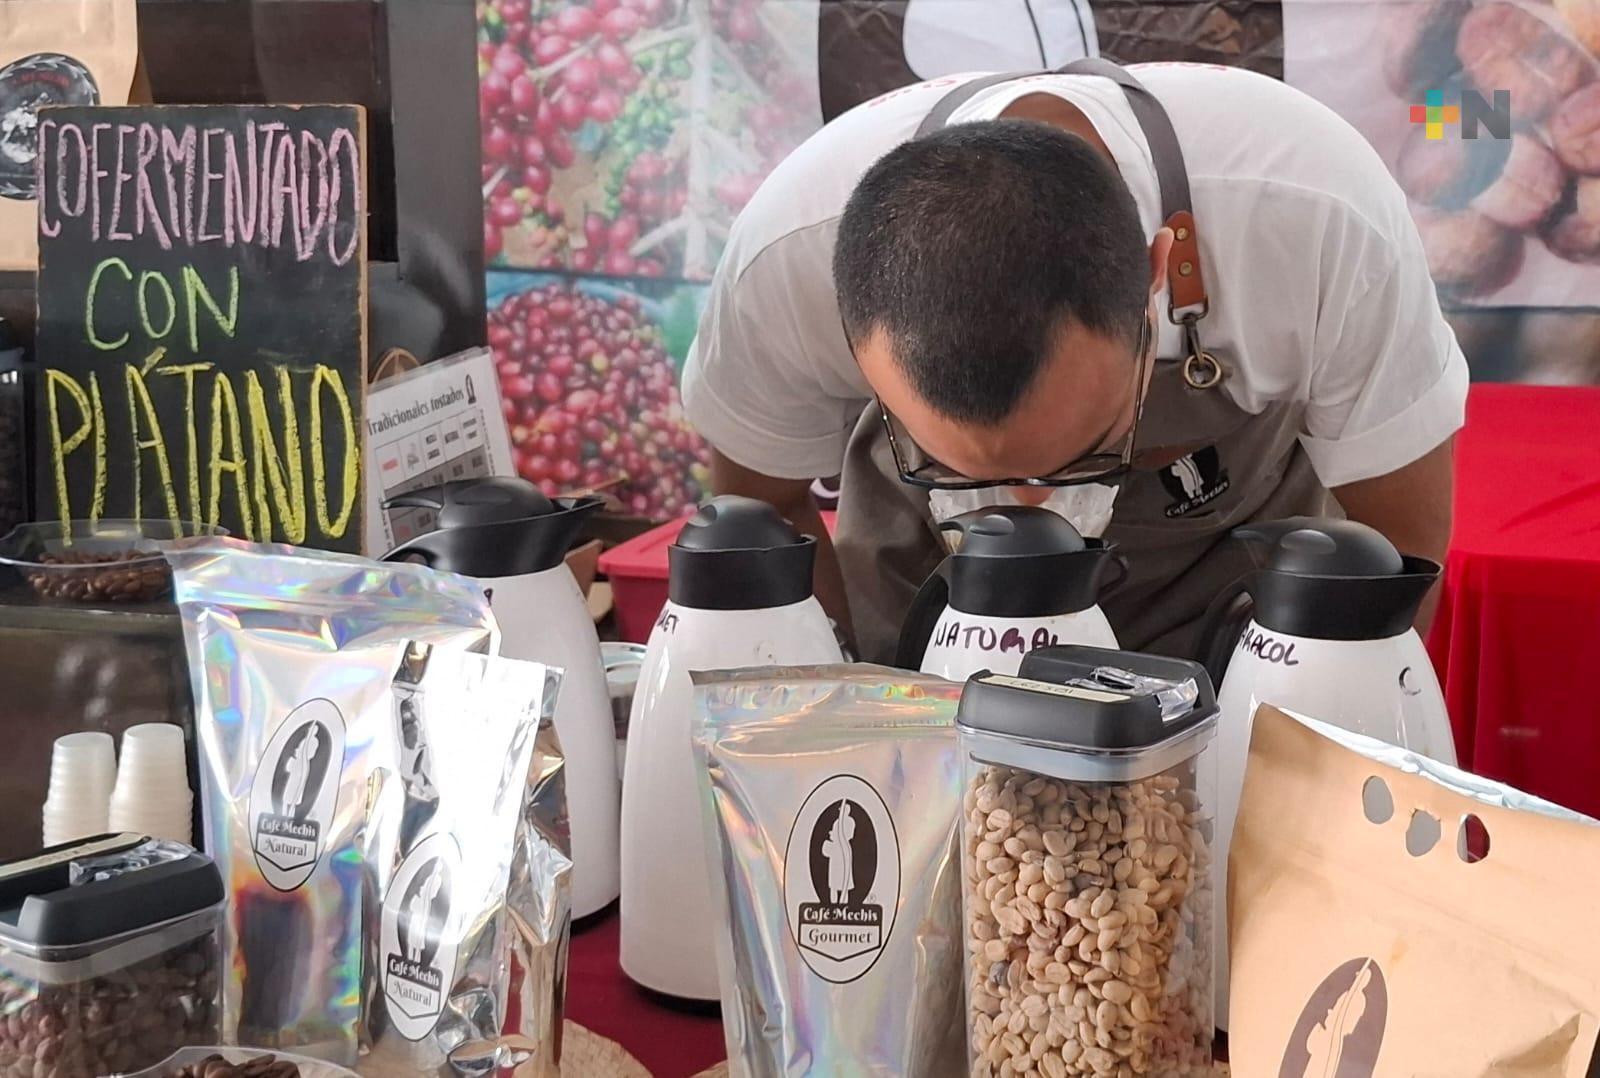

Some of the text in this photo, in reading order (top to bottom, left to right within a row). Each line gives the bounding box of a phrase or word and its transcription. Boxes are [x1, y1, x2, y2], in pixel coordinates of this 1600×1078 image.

[37, 120, 360, 267] COFERMENTADO
[86, 257, 239, 352] CON
[366, 399, 430, 437] Tradicionales
[46, 346, 361, 547] PLÁTANO
[281, 820, 316, 837] Mechis
[264, 838, 308, 857] Natural
[803, 906, 878, 923] Café Mechis
[808, 928, 873, 947] Gourmet
[389, 958, 440, 987] Café Mechis
[393, 979, 432, 1007] Natural
